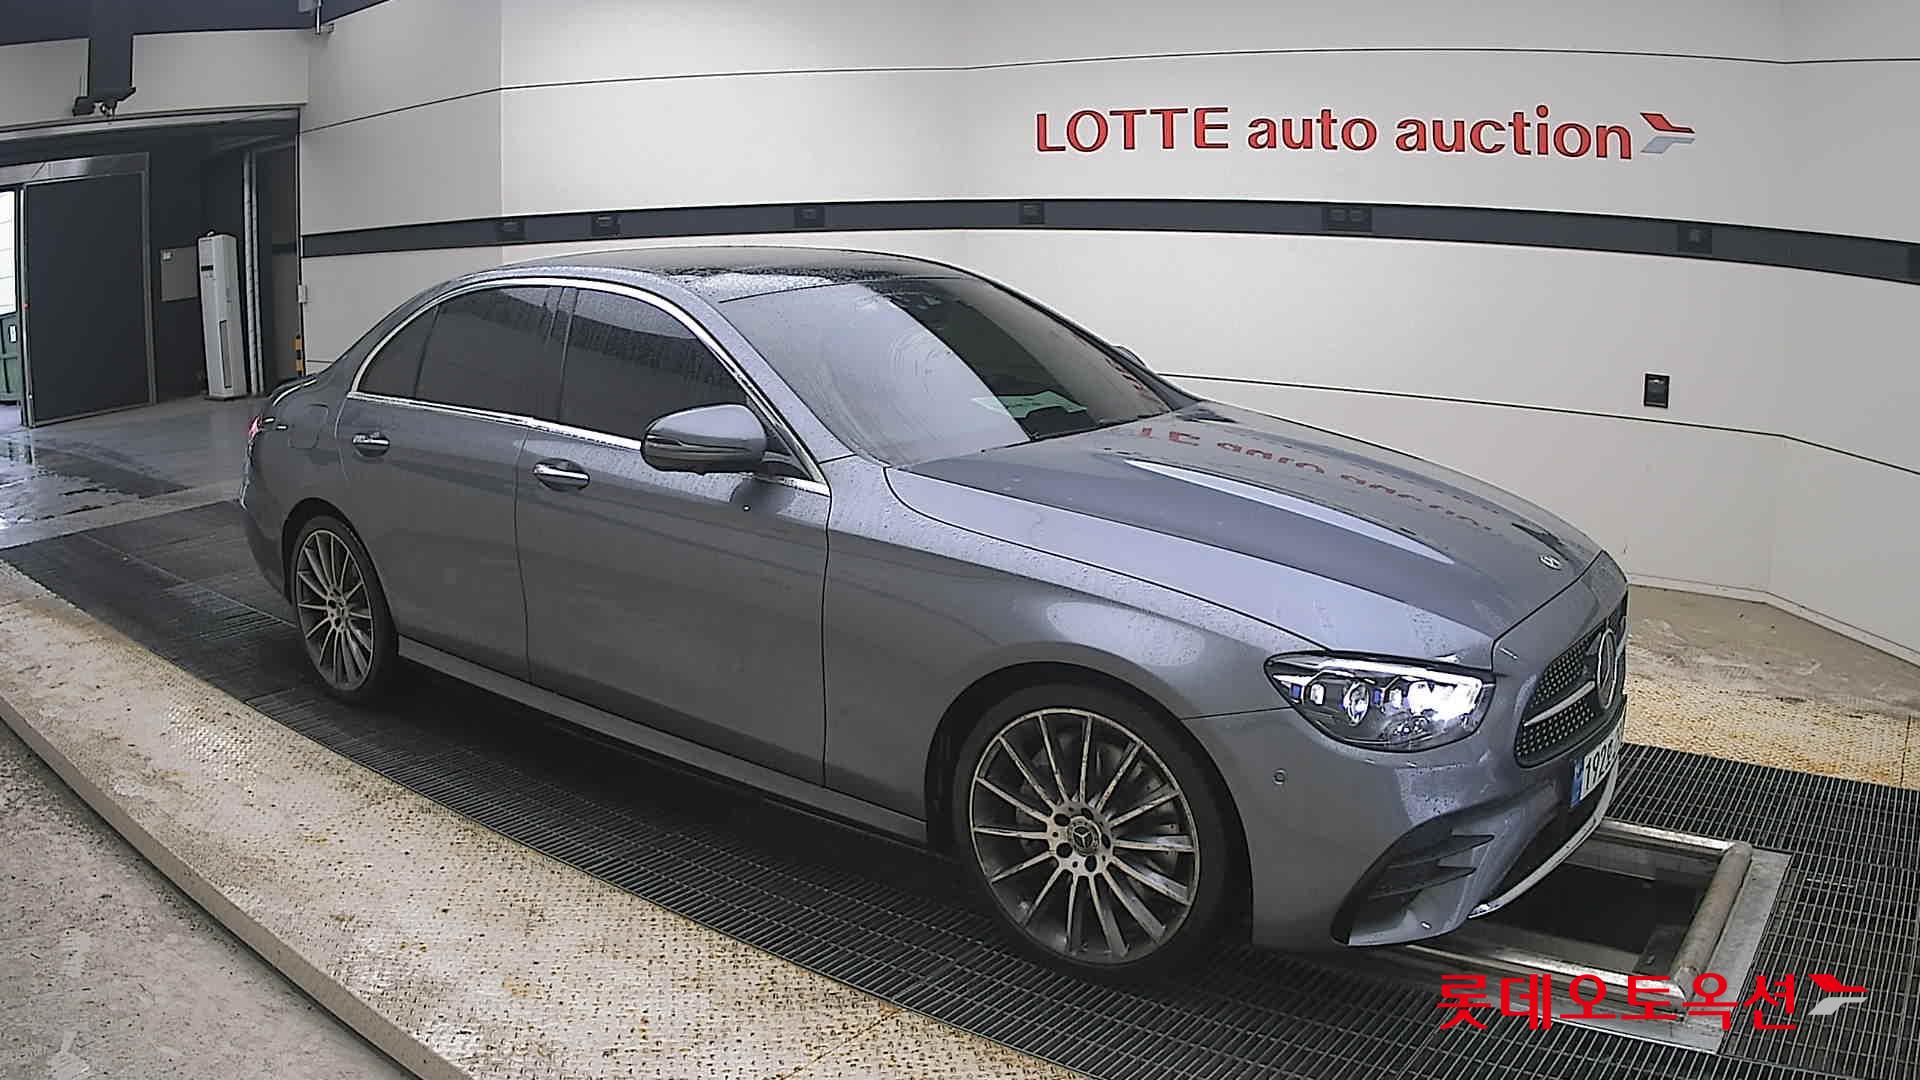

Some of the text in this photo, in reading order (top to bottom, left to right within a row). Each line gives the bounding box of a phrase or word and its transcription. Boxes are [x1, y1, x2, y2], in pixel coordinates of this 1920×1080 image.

[1035, 104, 1633, 160] LOTTE auto auction
